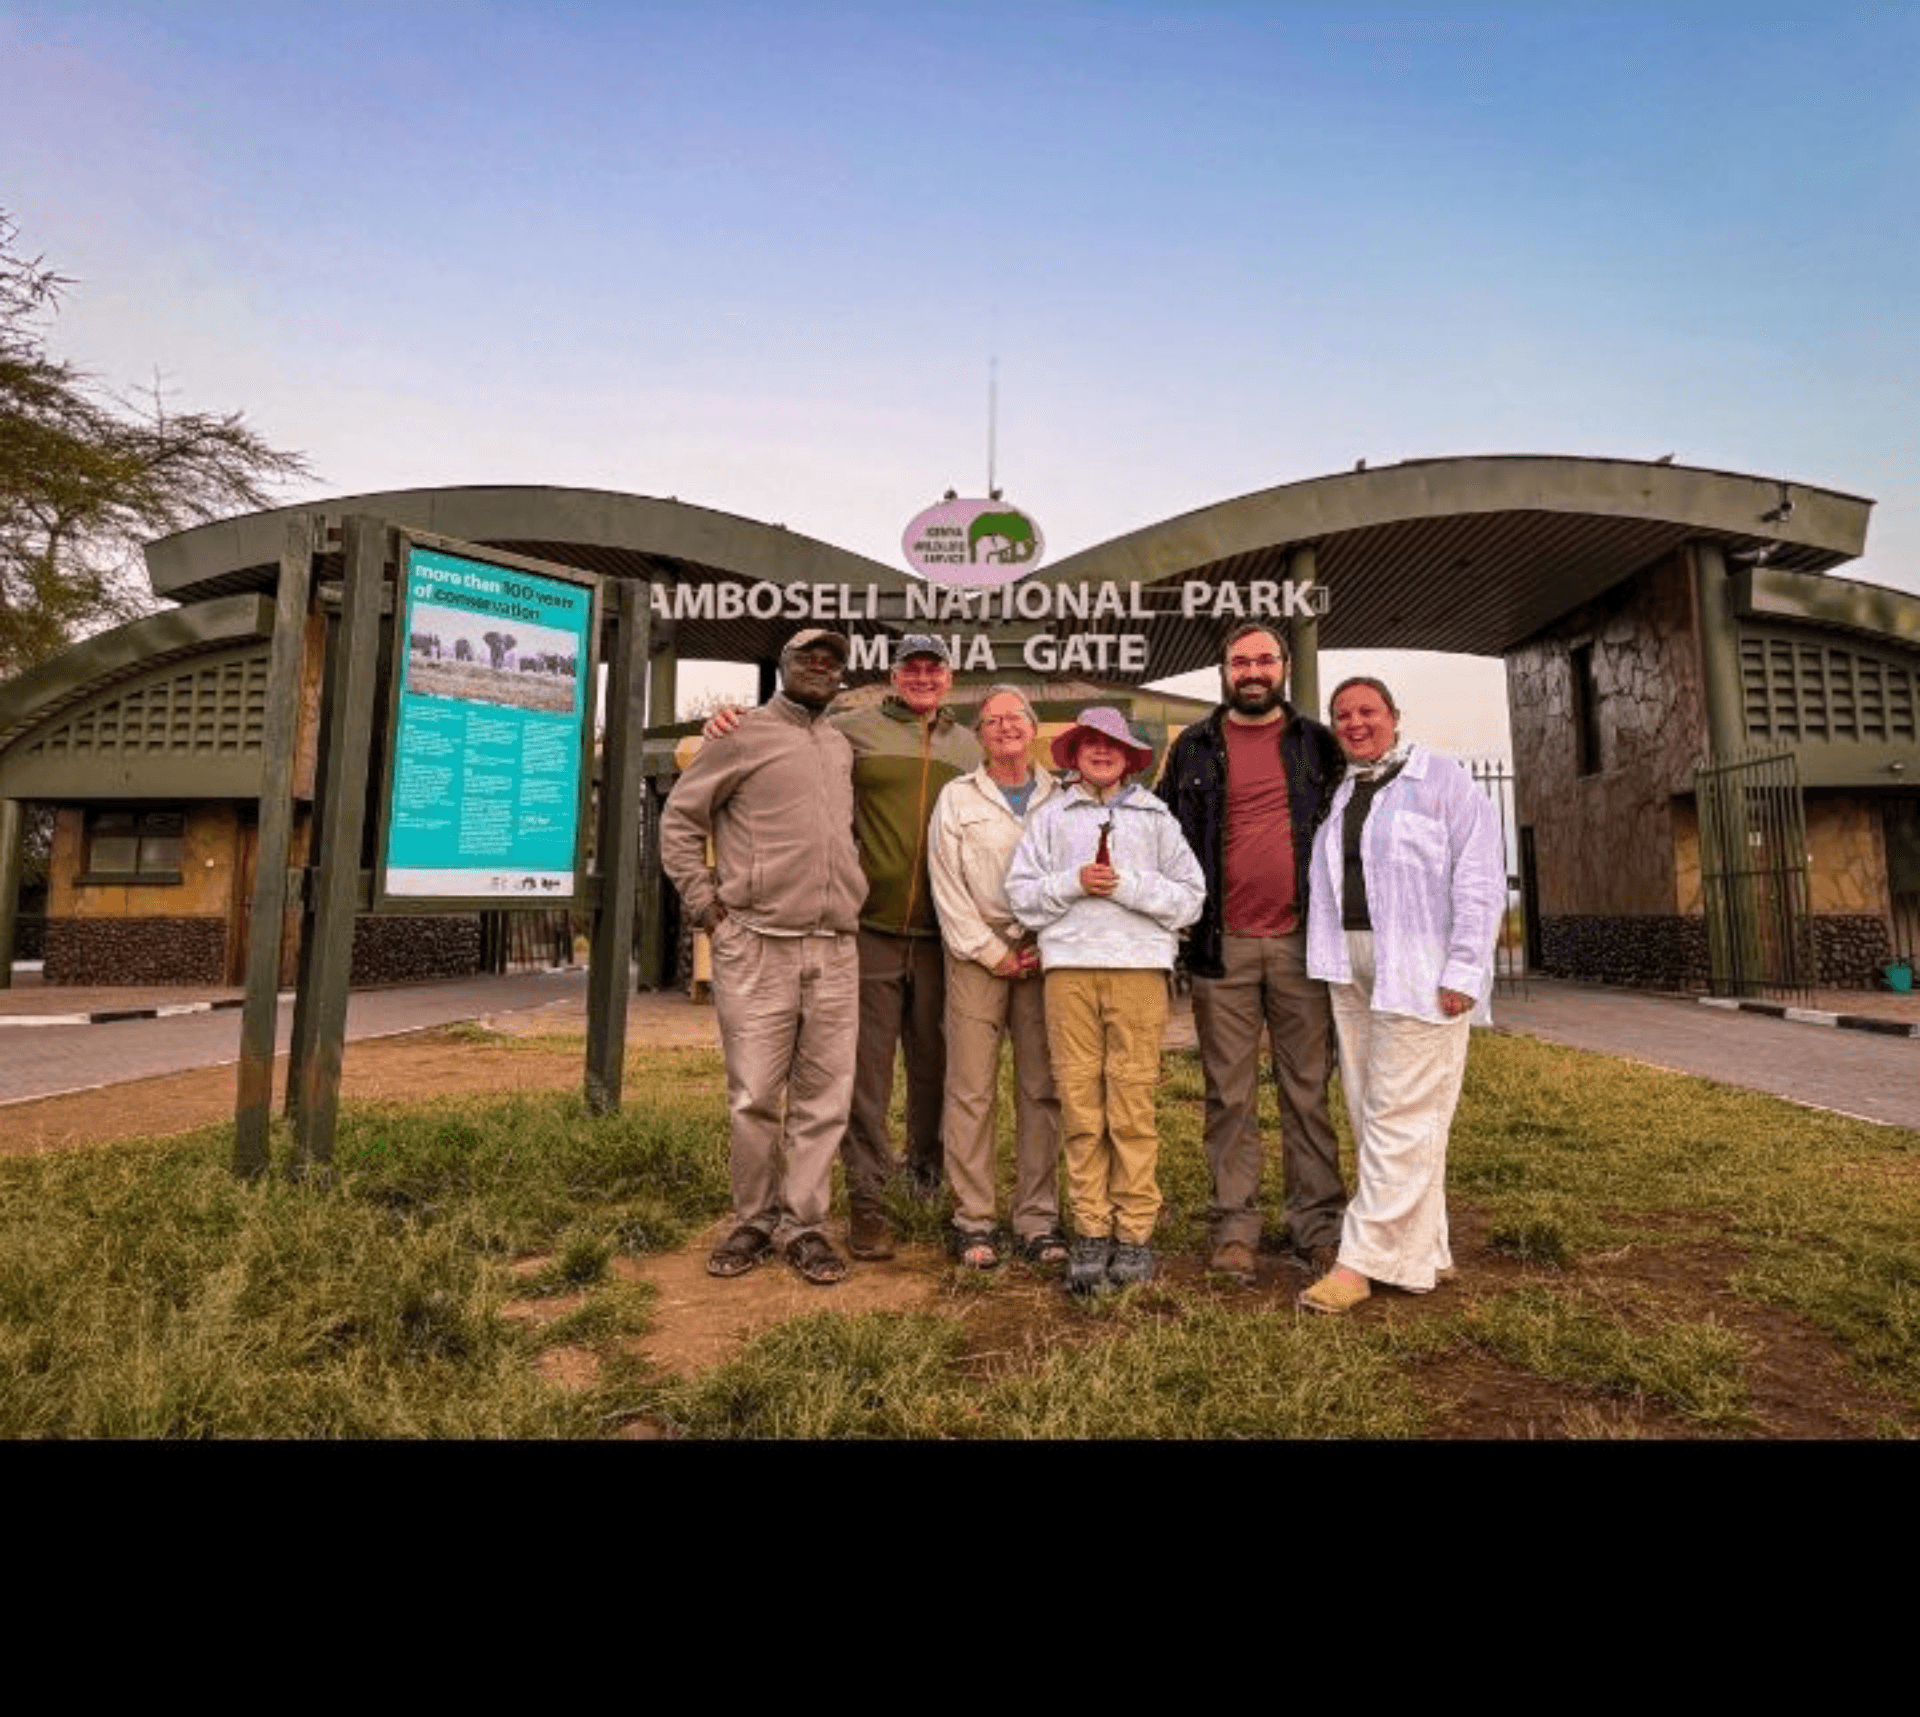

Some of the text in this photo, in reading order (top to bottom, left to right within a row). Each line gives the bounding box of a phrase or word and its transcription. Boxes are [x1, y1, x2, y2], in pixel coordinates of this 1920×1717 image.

[413, 583, 433, 599] of
[415, 565, 462, 586] more
[463, 573, 501, 593] than
[650, 580, 1316, 620] AMBOSELI NATIONAL PARK
[1023, 633, 1147, 671] GATE
